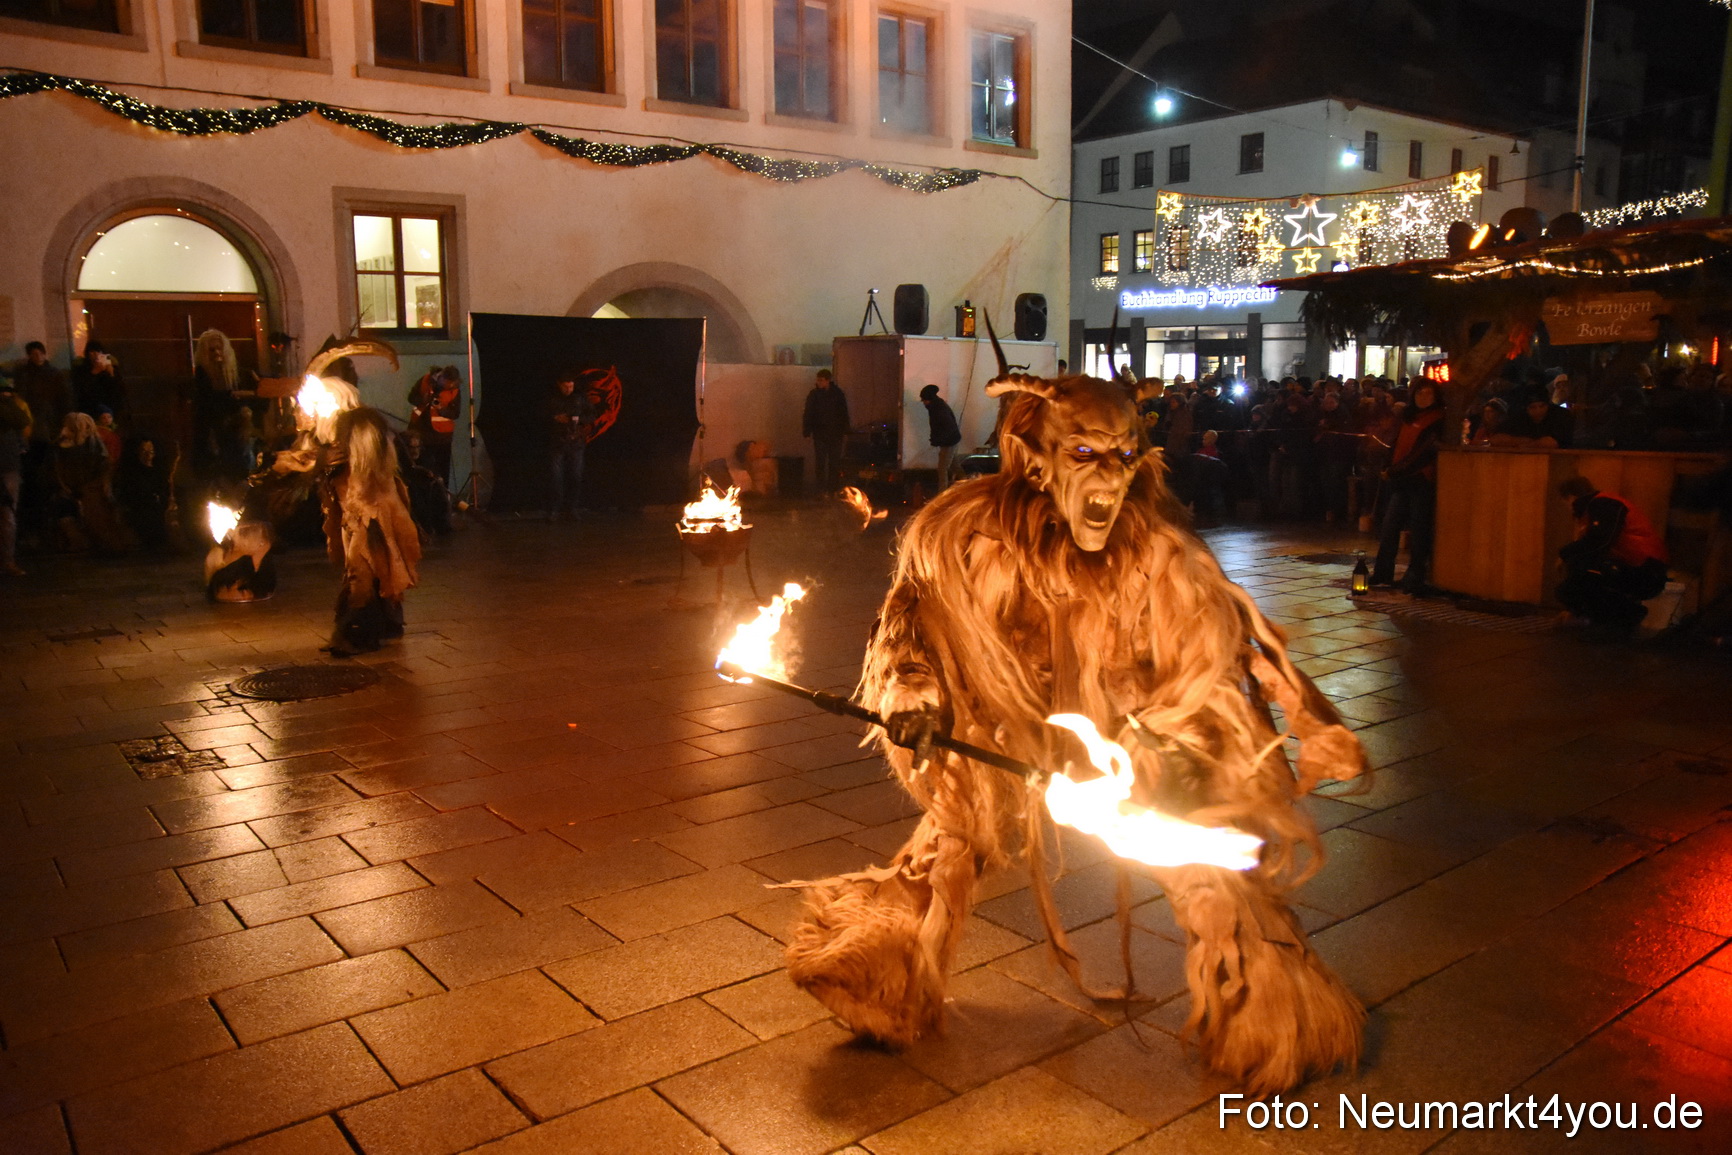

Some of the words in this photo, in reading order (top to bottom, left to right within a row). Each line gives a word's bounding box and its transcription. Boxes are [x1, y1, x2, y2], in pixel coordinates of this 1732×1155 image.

[1121, 288, 1206, 309] Buchhandlung
[1207, 286, 1275, 307] Rupprecht
[1577, 321, 1622, 337] Bowle
